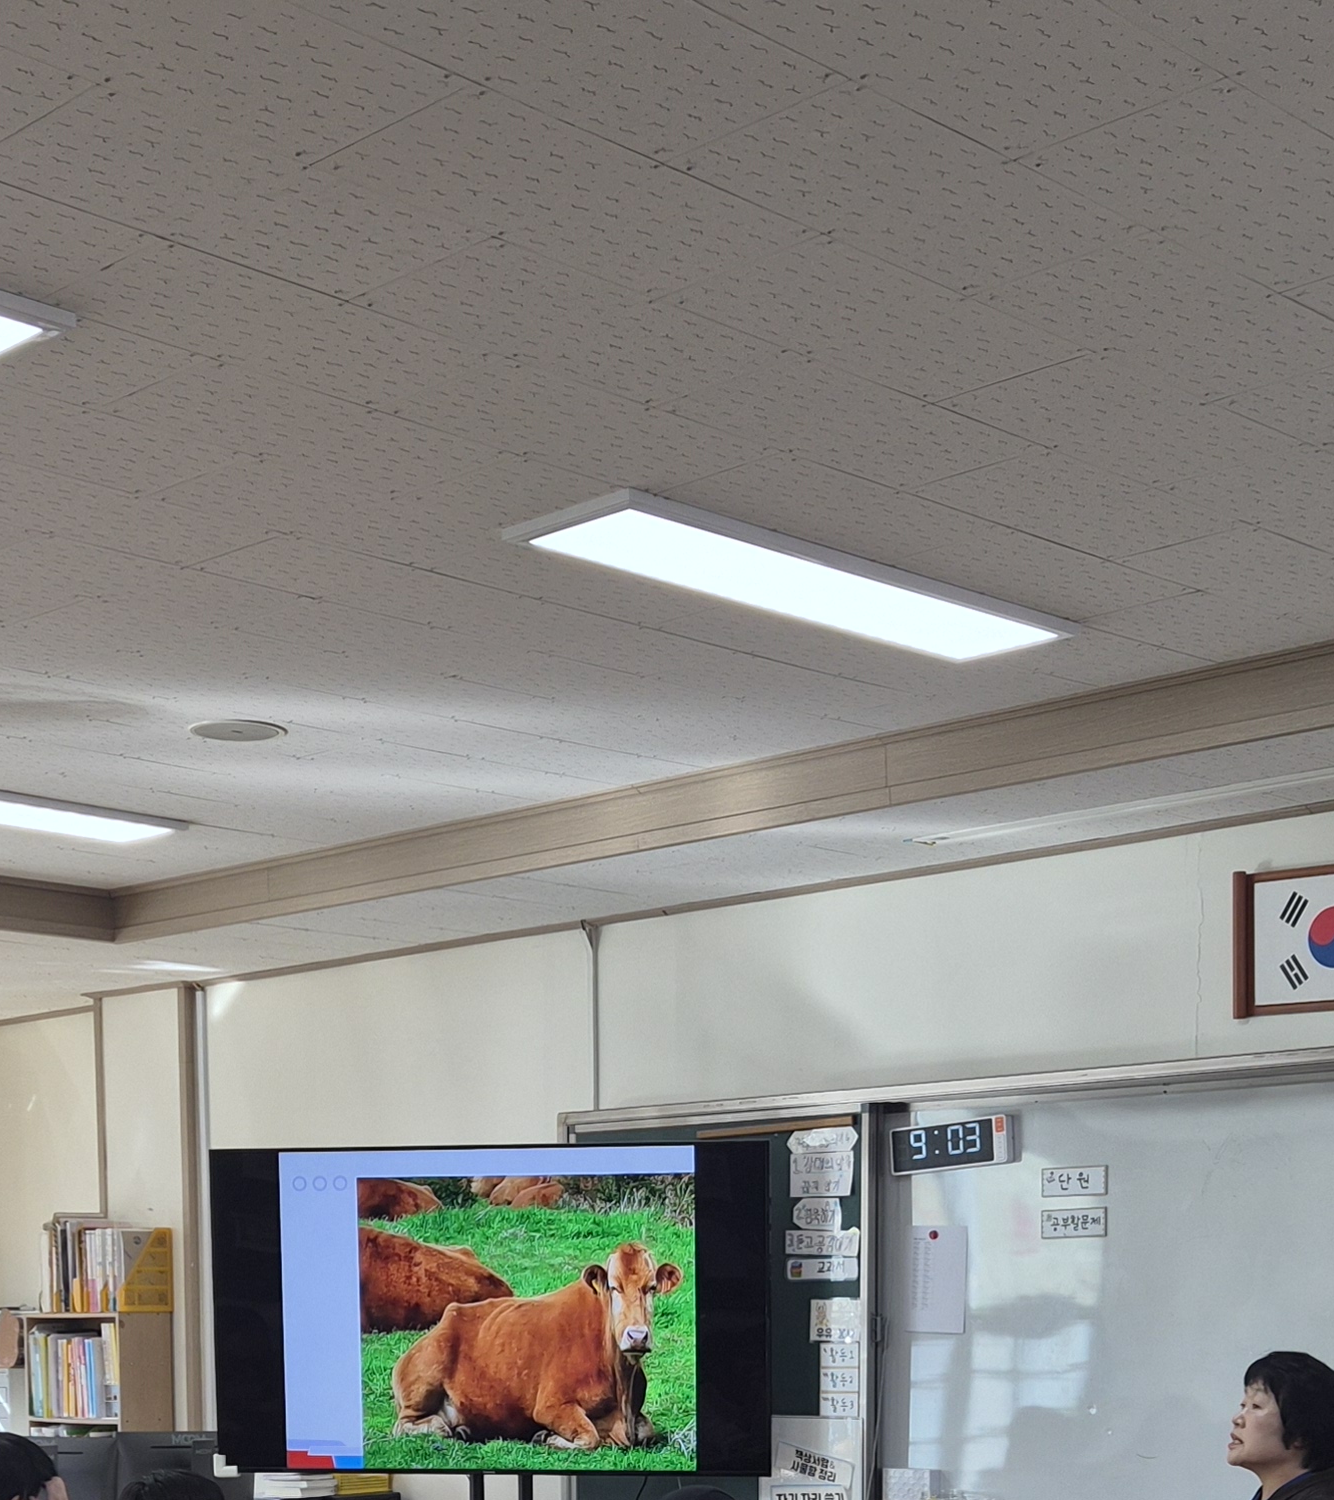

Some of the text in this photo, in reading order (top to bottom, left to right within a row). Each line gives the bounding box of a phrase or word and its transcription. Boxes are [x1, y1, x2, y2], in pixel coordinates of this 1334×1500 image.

[909, 1122, 981, 1160] 9:03
[816, 1327, 832, 1339] 우유
[791, 1460, 836, 1483] 사물함 정리
